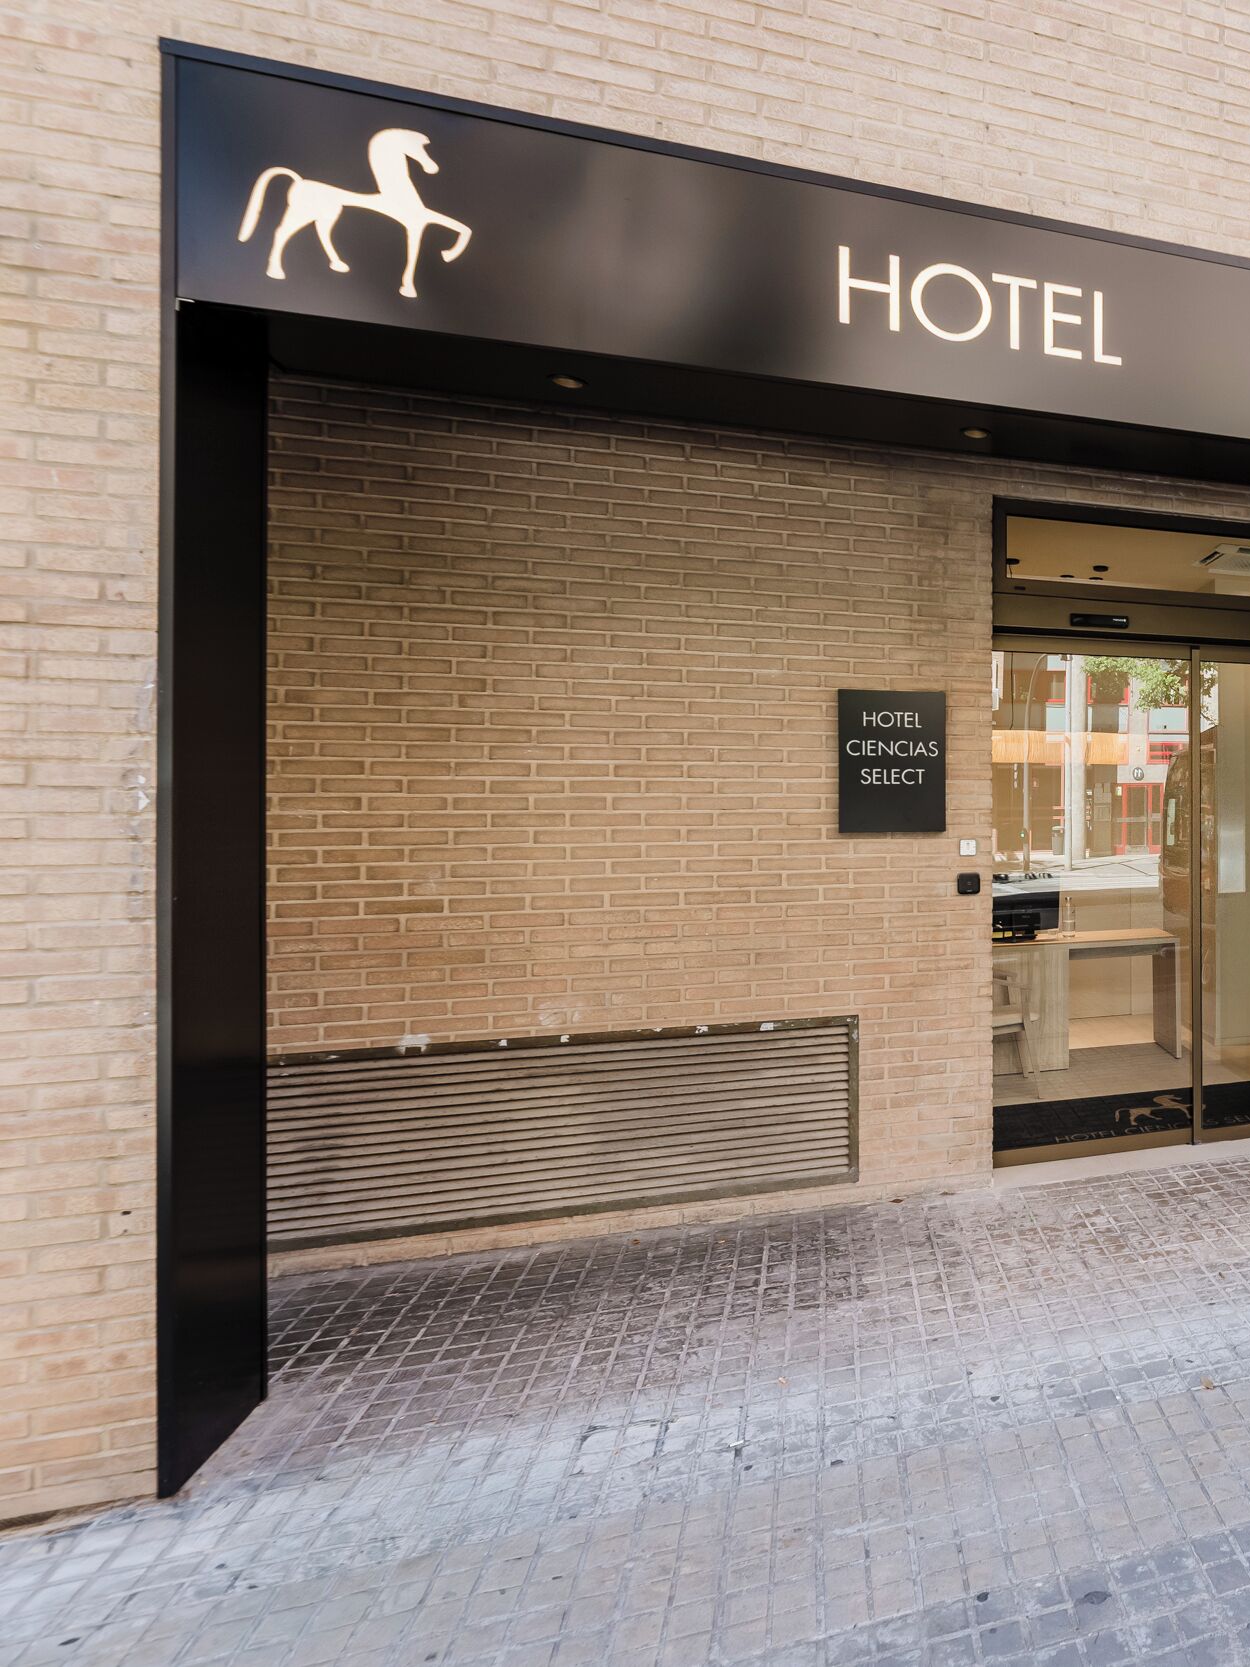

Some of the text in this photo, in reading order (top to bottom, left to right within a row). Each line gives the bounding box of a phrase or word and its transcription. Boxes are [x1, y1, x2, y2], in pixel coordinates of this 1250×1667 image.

[838, 245, 1122, 366] HOTEL
[862, 711, 922, 728] HOTEL
[846, 739, 939, 757] CIENCIAS
[860, 768, 926, 785] SELECT
